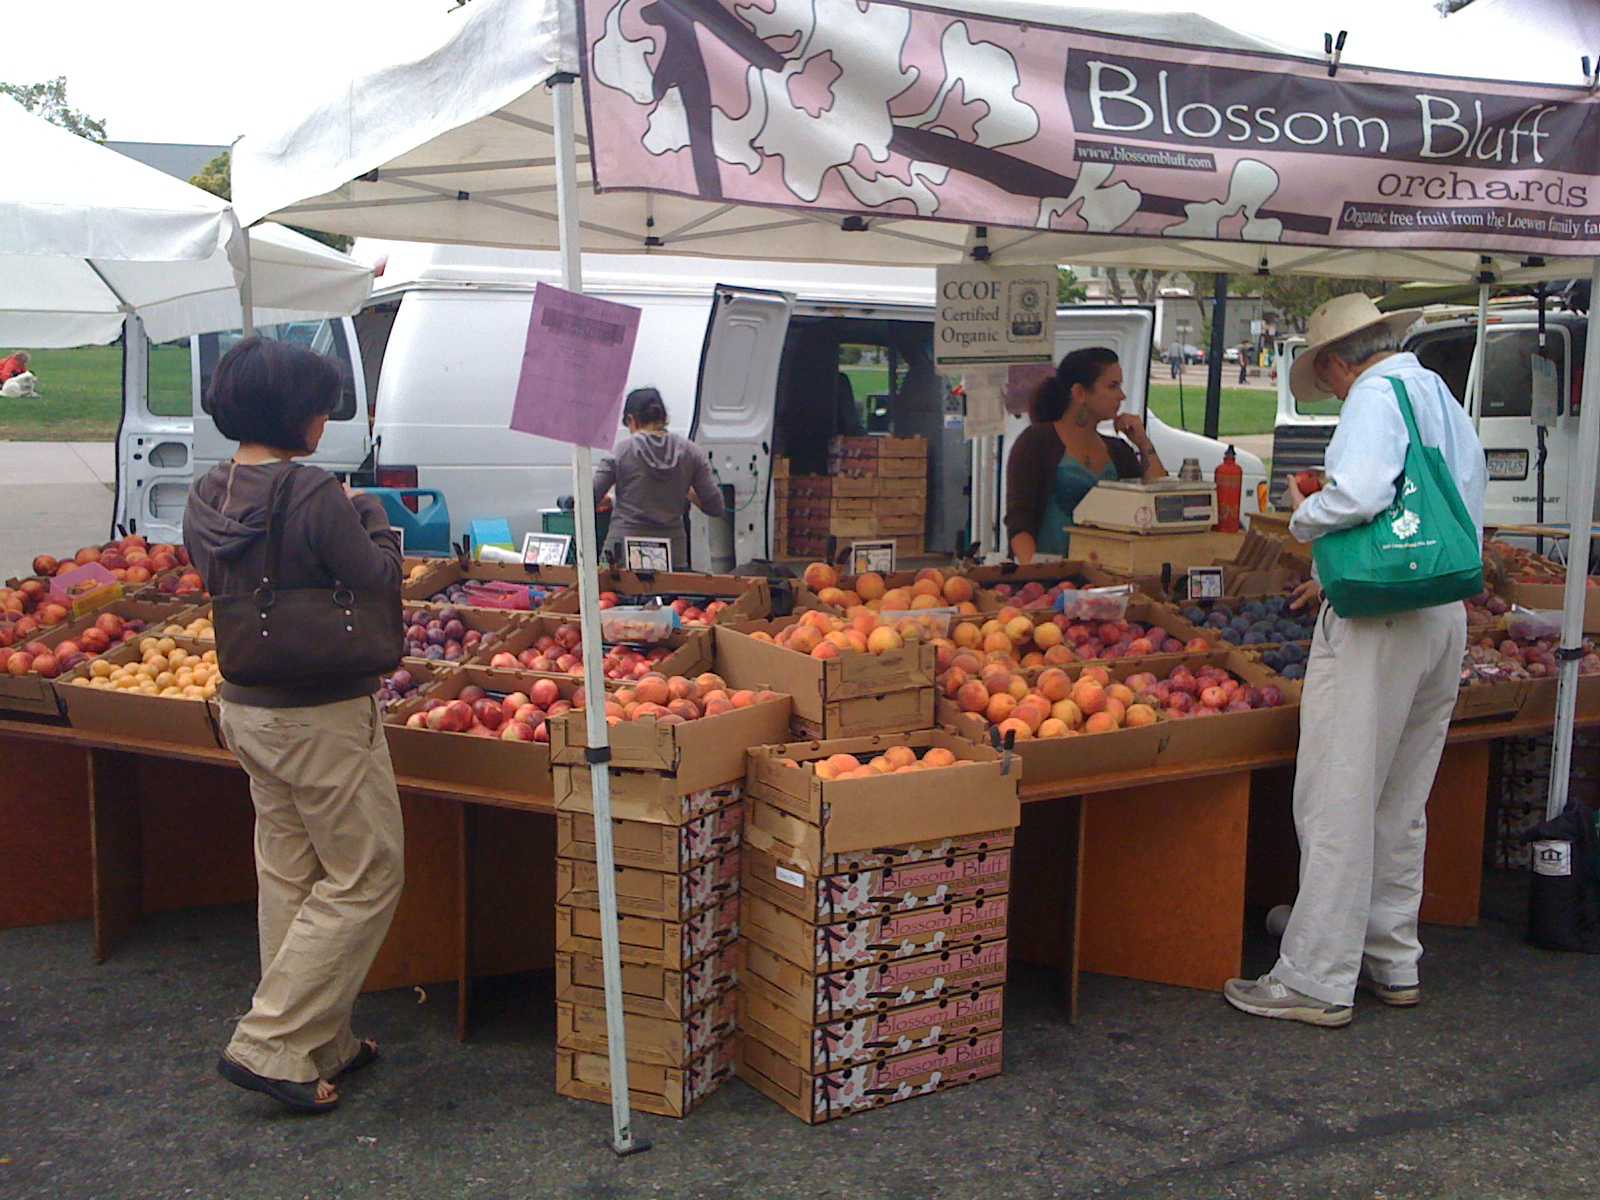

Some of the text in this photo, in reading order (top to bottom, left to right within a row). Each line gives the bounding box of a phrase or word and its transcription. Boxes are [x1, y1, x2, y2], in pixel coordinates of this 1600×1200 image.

[1087, 60, 1557, 164] Blossom Bluff
[1077, 146, 1213, 168] www.blossombluff.com
[1377, 171, 1588, 208] orchards
[1343, 206, 1387, 228] Organic
[1389, 208, 1414, 226] tree
[1416, 209, 1450, 226] fruit
[1451, 209, 1484, 226] from
[1487, 210, 1505, 229] the
[1548, 215, 1580, 238] family
[943, 280, 1000, 300] CCOF
[942, 305, 1000, 321] Certified
[941, 326, 999, 347] Organic
